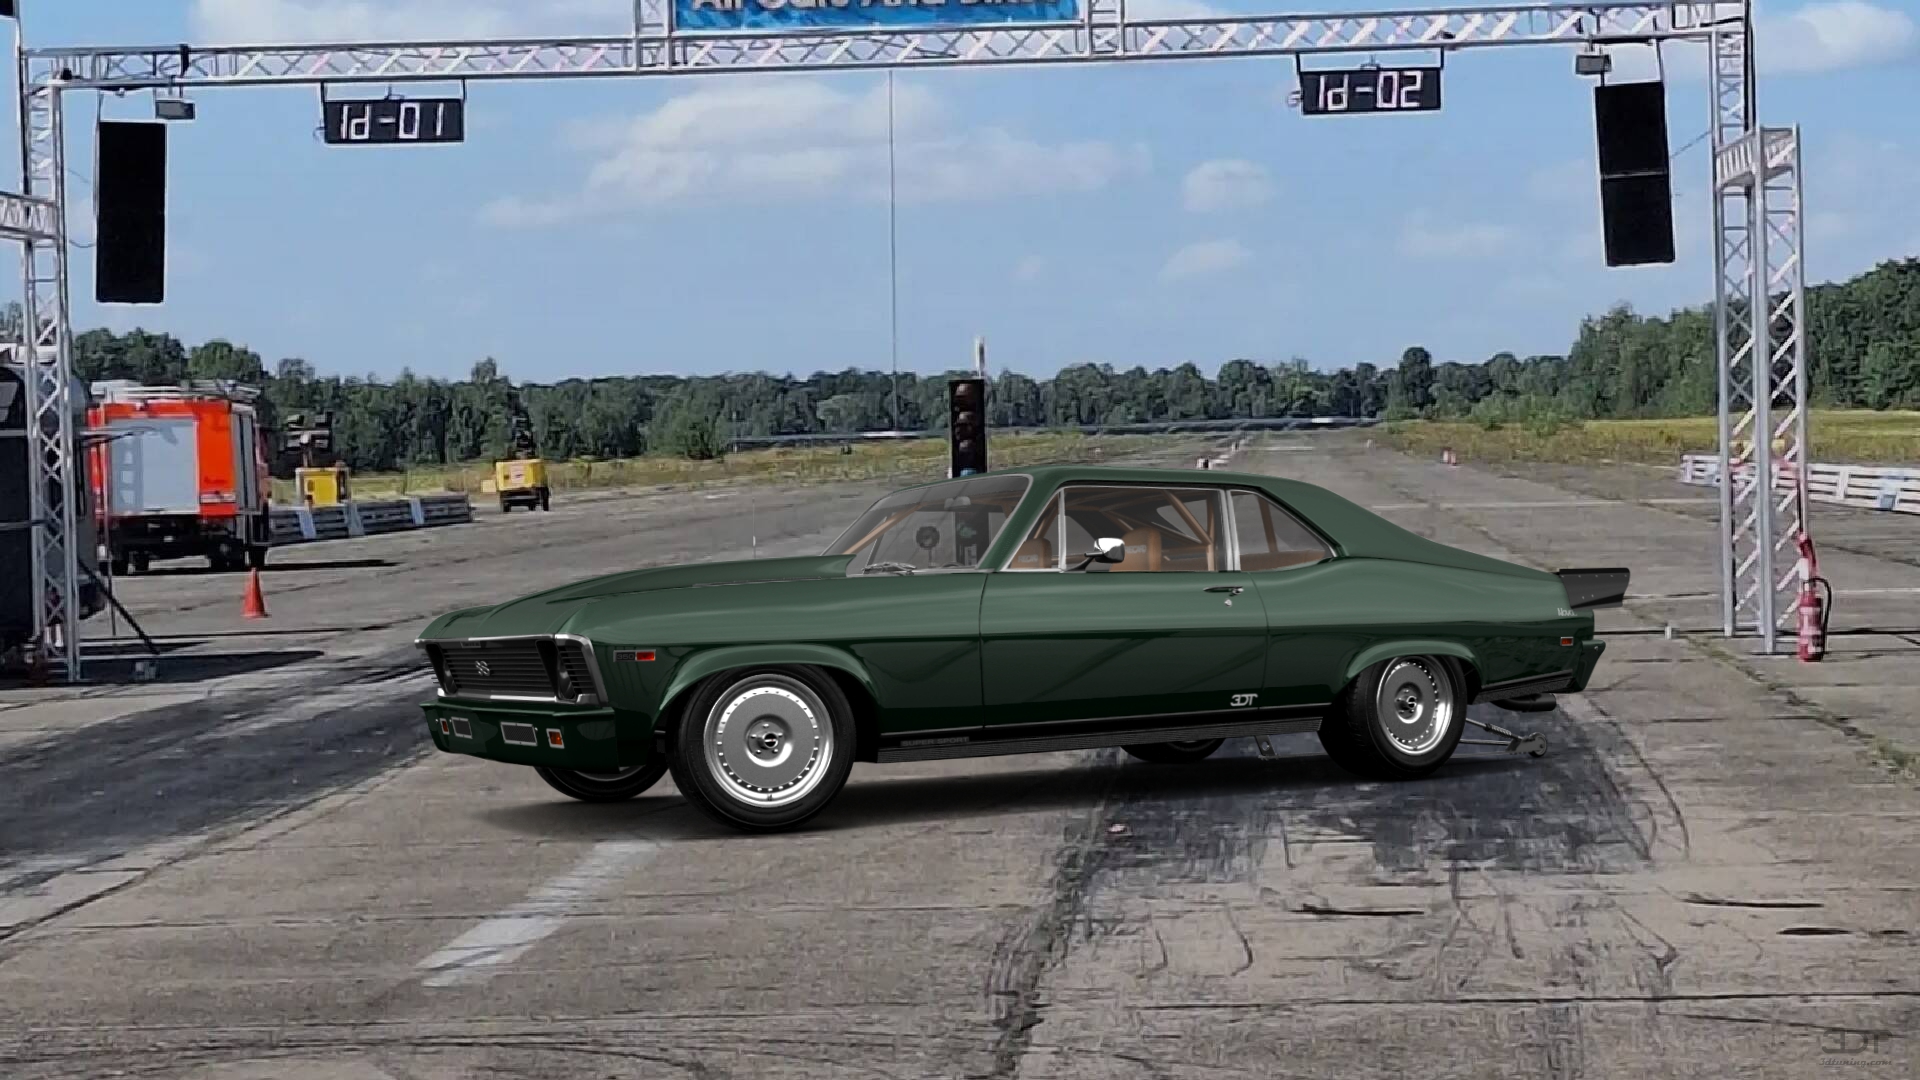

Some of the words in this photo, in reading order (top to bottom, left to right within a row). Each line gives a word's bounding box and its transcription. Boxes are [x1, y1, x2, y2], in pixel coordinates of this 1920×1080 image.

[1230, 693, 1258, 707] 3DT
[901, 738, 934, 747] SUPER
[936, 736, 969, 744] SPORT
